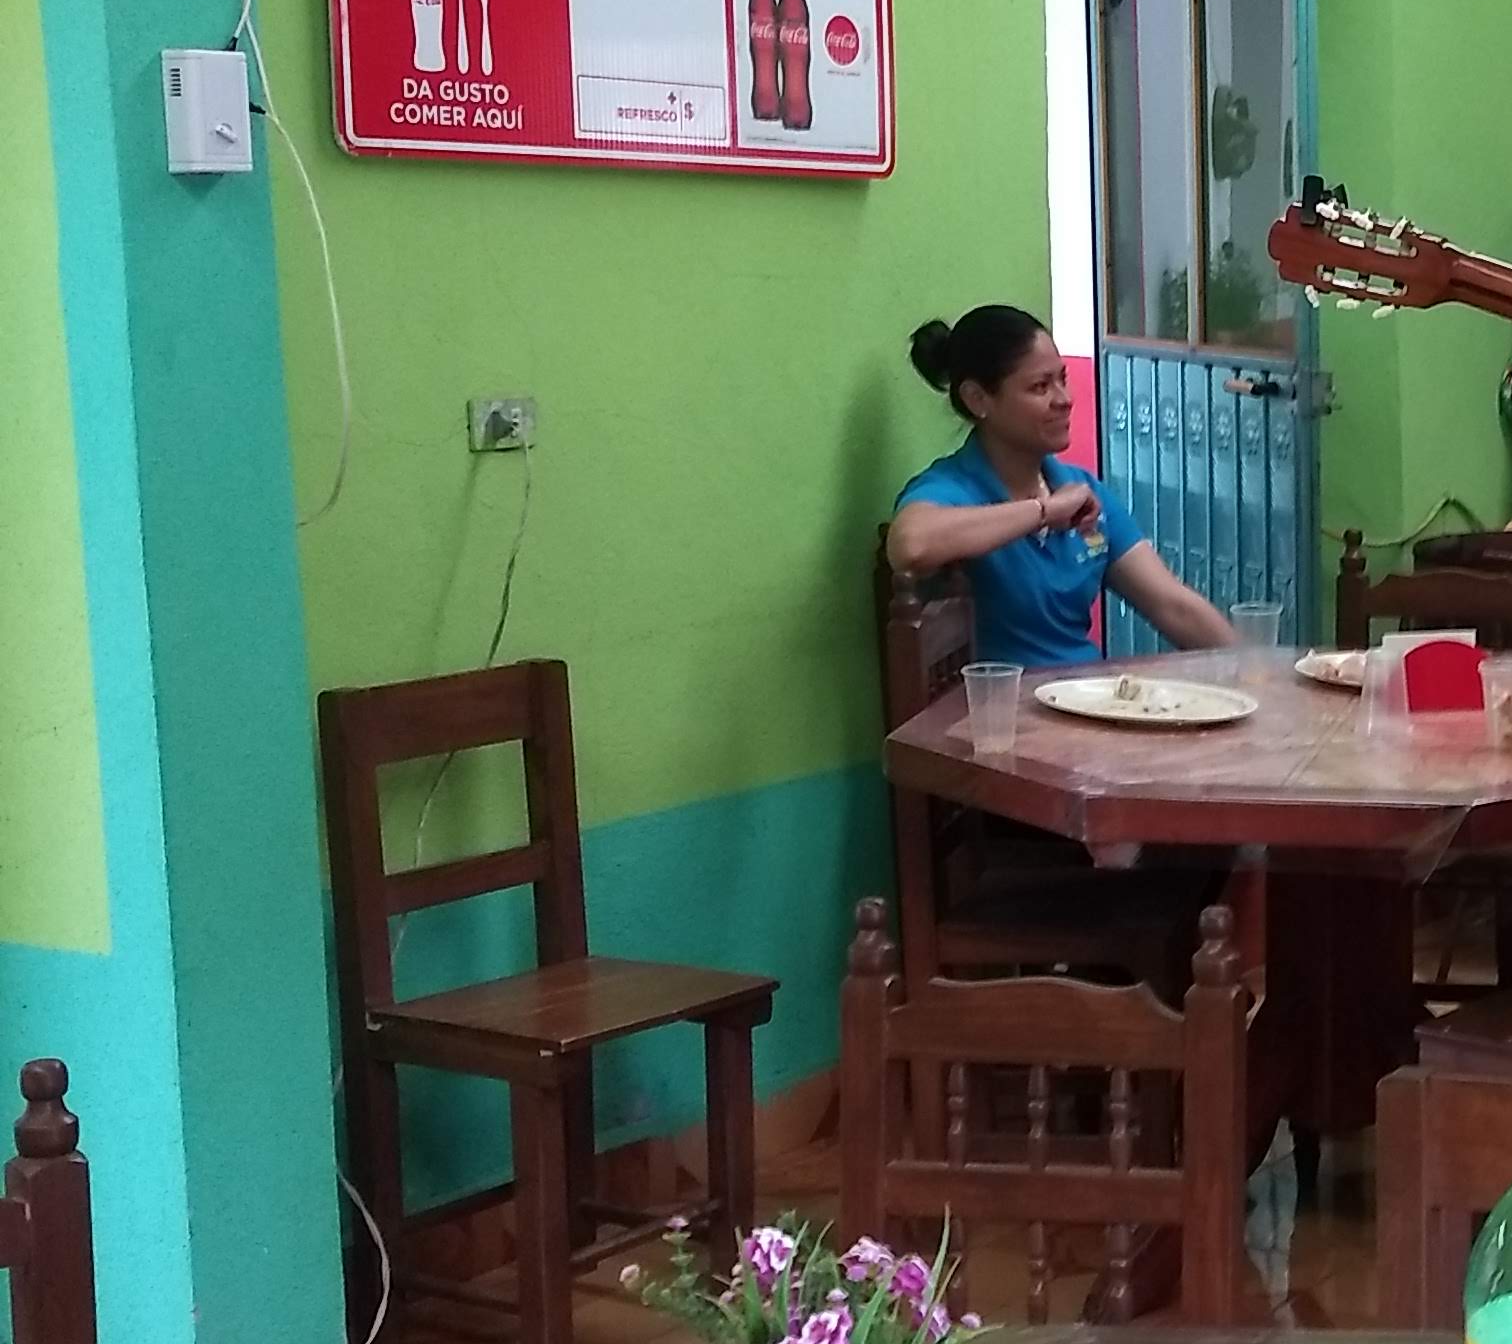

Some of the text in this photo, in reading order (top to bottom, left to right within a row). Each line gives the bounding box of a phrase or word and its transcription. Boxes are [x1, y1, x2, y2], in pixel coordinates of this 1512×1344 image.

[402, 77, 510, 104] DA GUSTO
[389, 102, 524, 130] COMER AQUÍ
[617, 101, 695, 123] REFRESCO $
